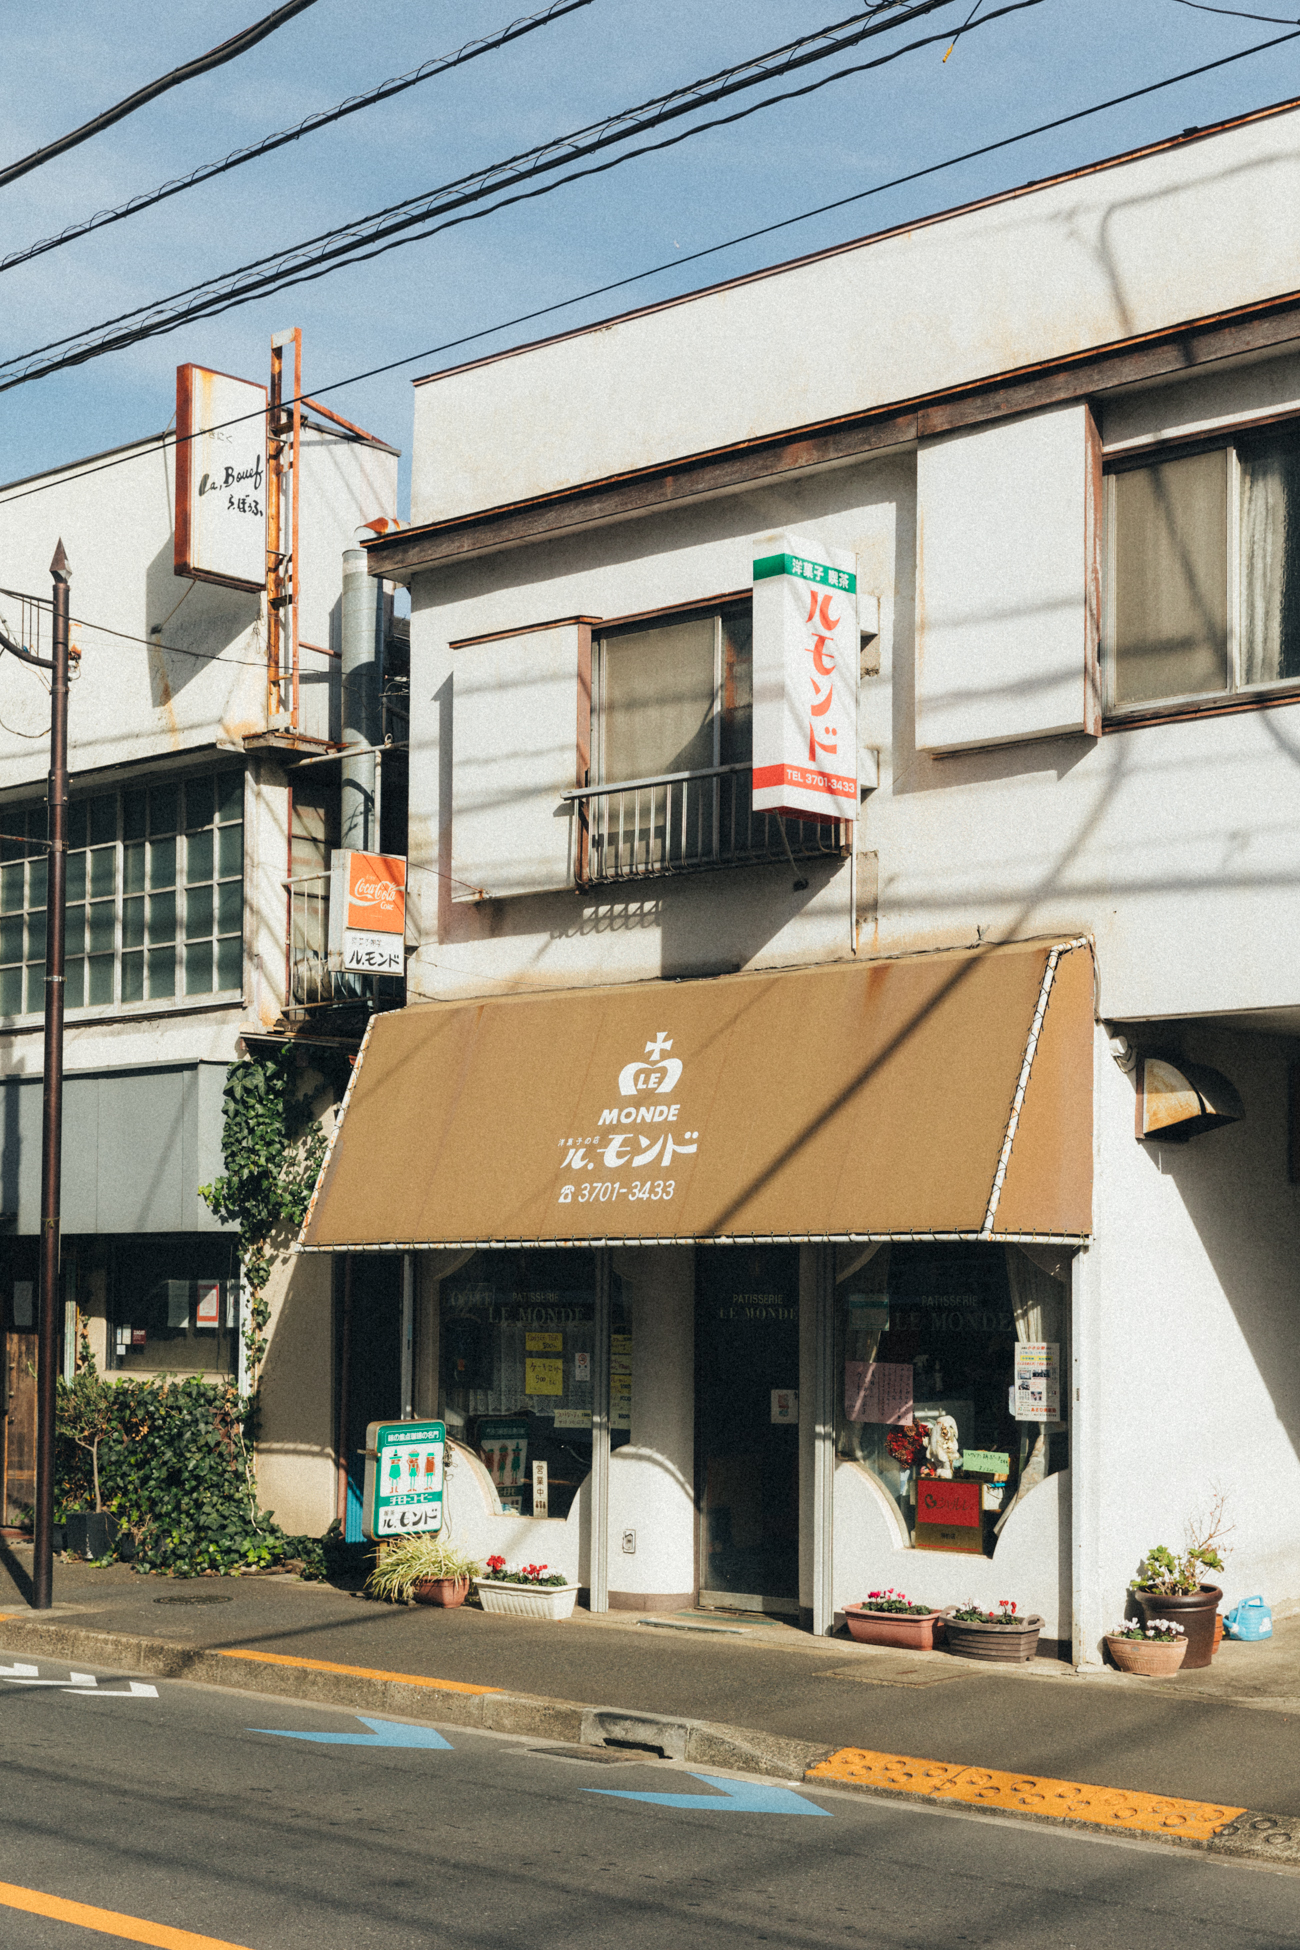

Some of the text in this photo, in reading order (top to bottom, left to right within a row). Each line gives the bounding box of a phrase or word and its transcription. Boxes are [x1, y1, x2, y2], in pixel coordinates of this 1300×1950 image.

[792, 558, 849, 590] 洋菓子 喫茶
[805, 589, 841, 762] ルモンド
[786, 769, 855, 793] TEL 3701-3433
[354, 877, 397, 901] Coca-Cola
[637, 1073, 661, 1089] LE
[597, 1104, 681, 1126] MONDE
[578, 1180, 675, 1202] 3701-3433
[512, 1292, 559, 1303] PATISSERIE
[732, 1294, 784, 1304] PATISSERIE
[921, 1295, 979, 1307] PATISSERIE
[489, 1306, 585, 1324] LE MONDE
[719, 1307, 798, 1320] LE MONDE
[931, 1311, 1012, 1331] MONDE
[535, 1464, 544, 1497] 営業中
